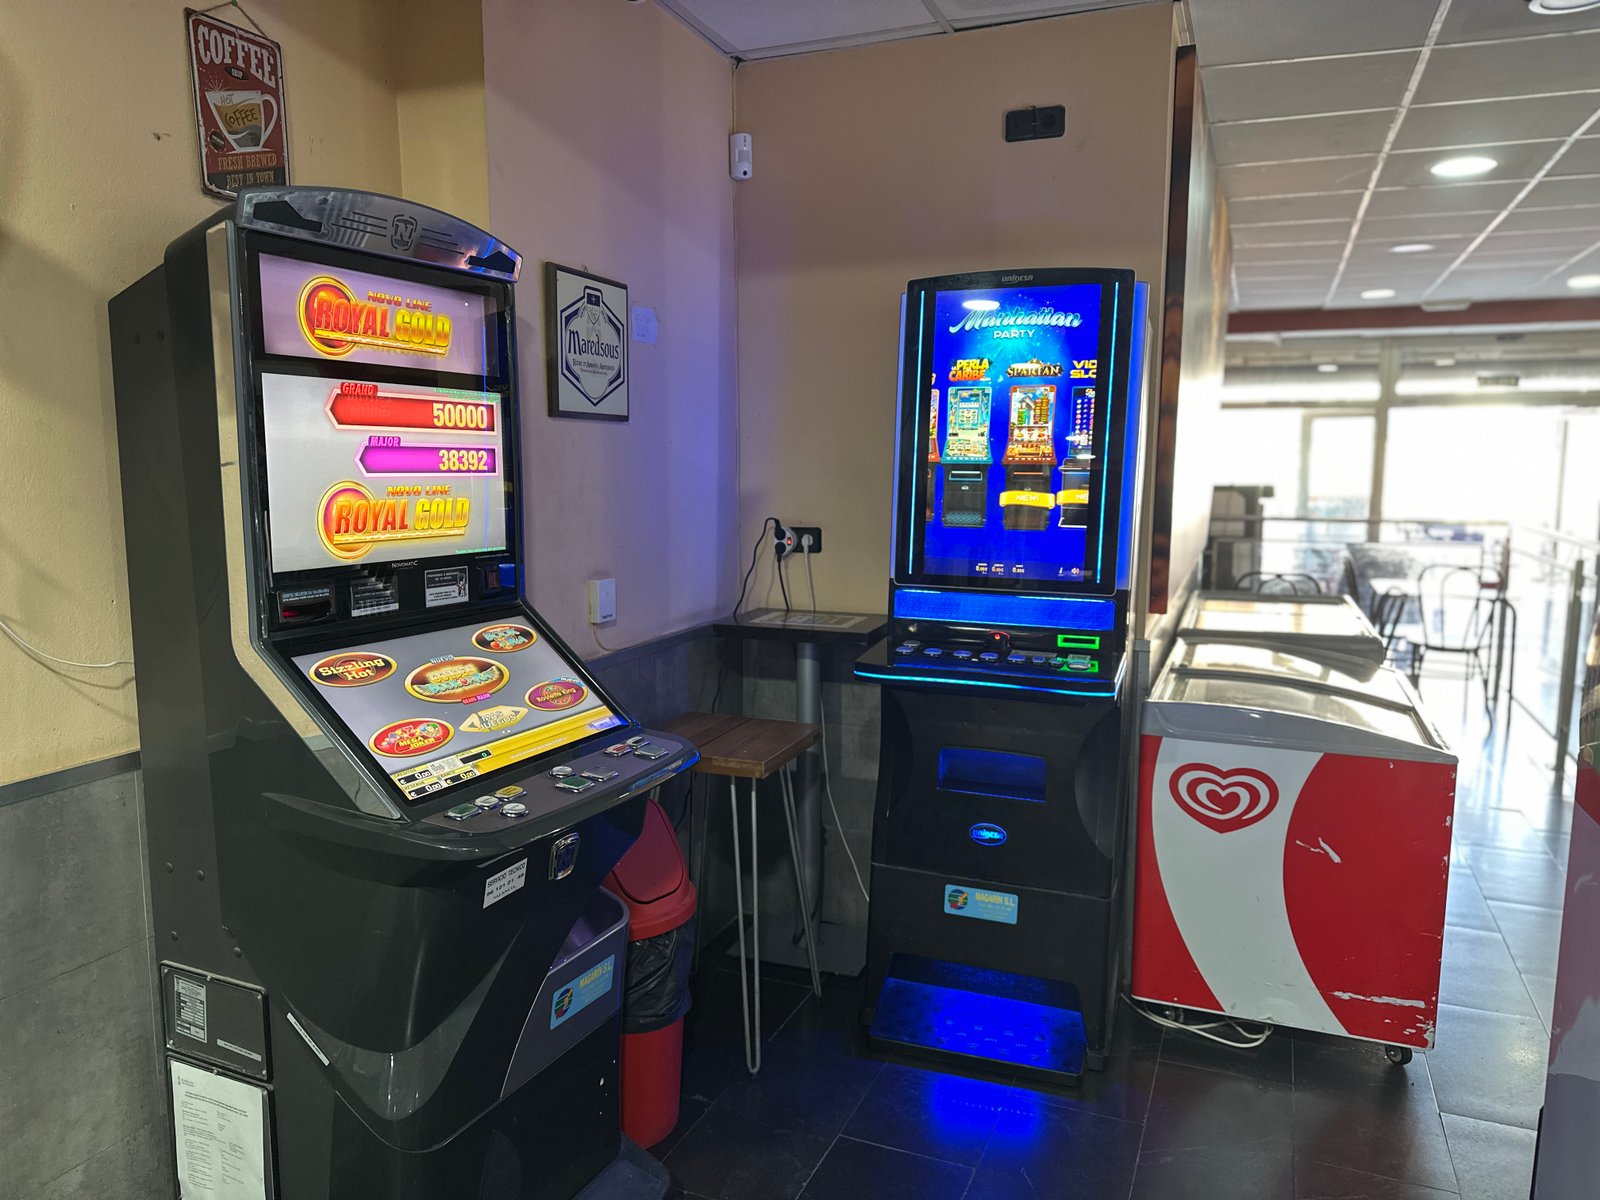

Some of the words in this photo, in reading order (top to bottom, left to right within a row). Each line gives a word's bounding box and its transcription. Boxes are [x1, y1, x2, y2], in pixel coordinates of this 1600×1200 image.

[198, 24, 276, 88] COFFEE
[220, 94, 234, 106] HOT
[225, 108, 258, 129] COFFEE
[218, 157, 243, 170] FRESH
[246, 153, 277, 167] BREWED
[226, 174, 243, 188] BEST
[246, 173, 254, 185] IN
[256, 170, 275, 184] TOWN
[367, 290, 402, 308] NOVO
[405, 297, 432, 312] LINE
[314, 297, 390, 339] ROYAL
[395, 309, 452, 348] GOLD
[949, 304, 1082, 333] Manhattan
[993, 329, 1036, 339] PARTY
[568, 329, 619, 360] Maredsous
[956, 358, 989, 371] PERLA
[949, 369, 986, 382] CARIBE
[343, 382, 374, 395] GRAND
[433, 403, 487, 429] 50000
[370, 436, 399, 447] MAJOR
[439, 450, 487, 471] 38392
[386, 486, 421, 497] NOVO
[425, 485, 451, 496] LINE
[334, 499, 409, 534] ROYAL
[414, 498, 470, 530] GOLD
[391, 560, 419, 568] NOVOMATIC
[319, 658, 386, 677] Sizzling
[344, 669, 375, 681] Hot
[480, 712, 518, 730] JUEGOS
[399, 736, 425, 747] MEGA
[409, 738, 436, 750] JOKER
[487, 872, 507, 889] SERVICIO
[508, 862, 526, 876] TECNICO
[975, 892, 1002, 905] MAGARIN
